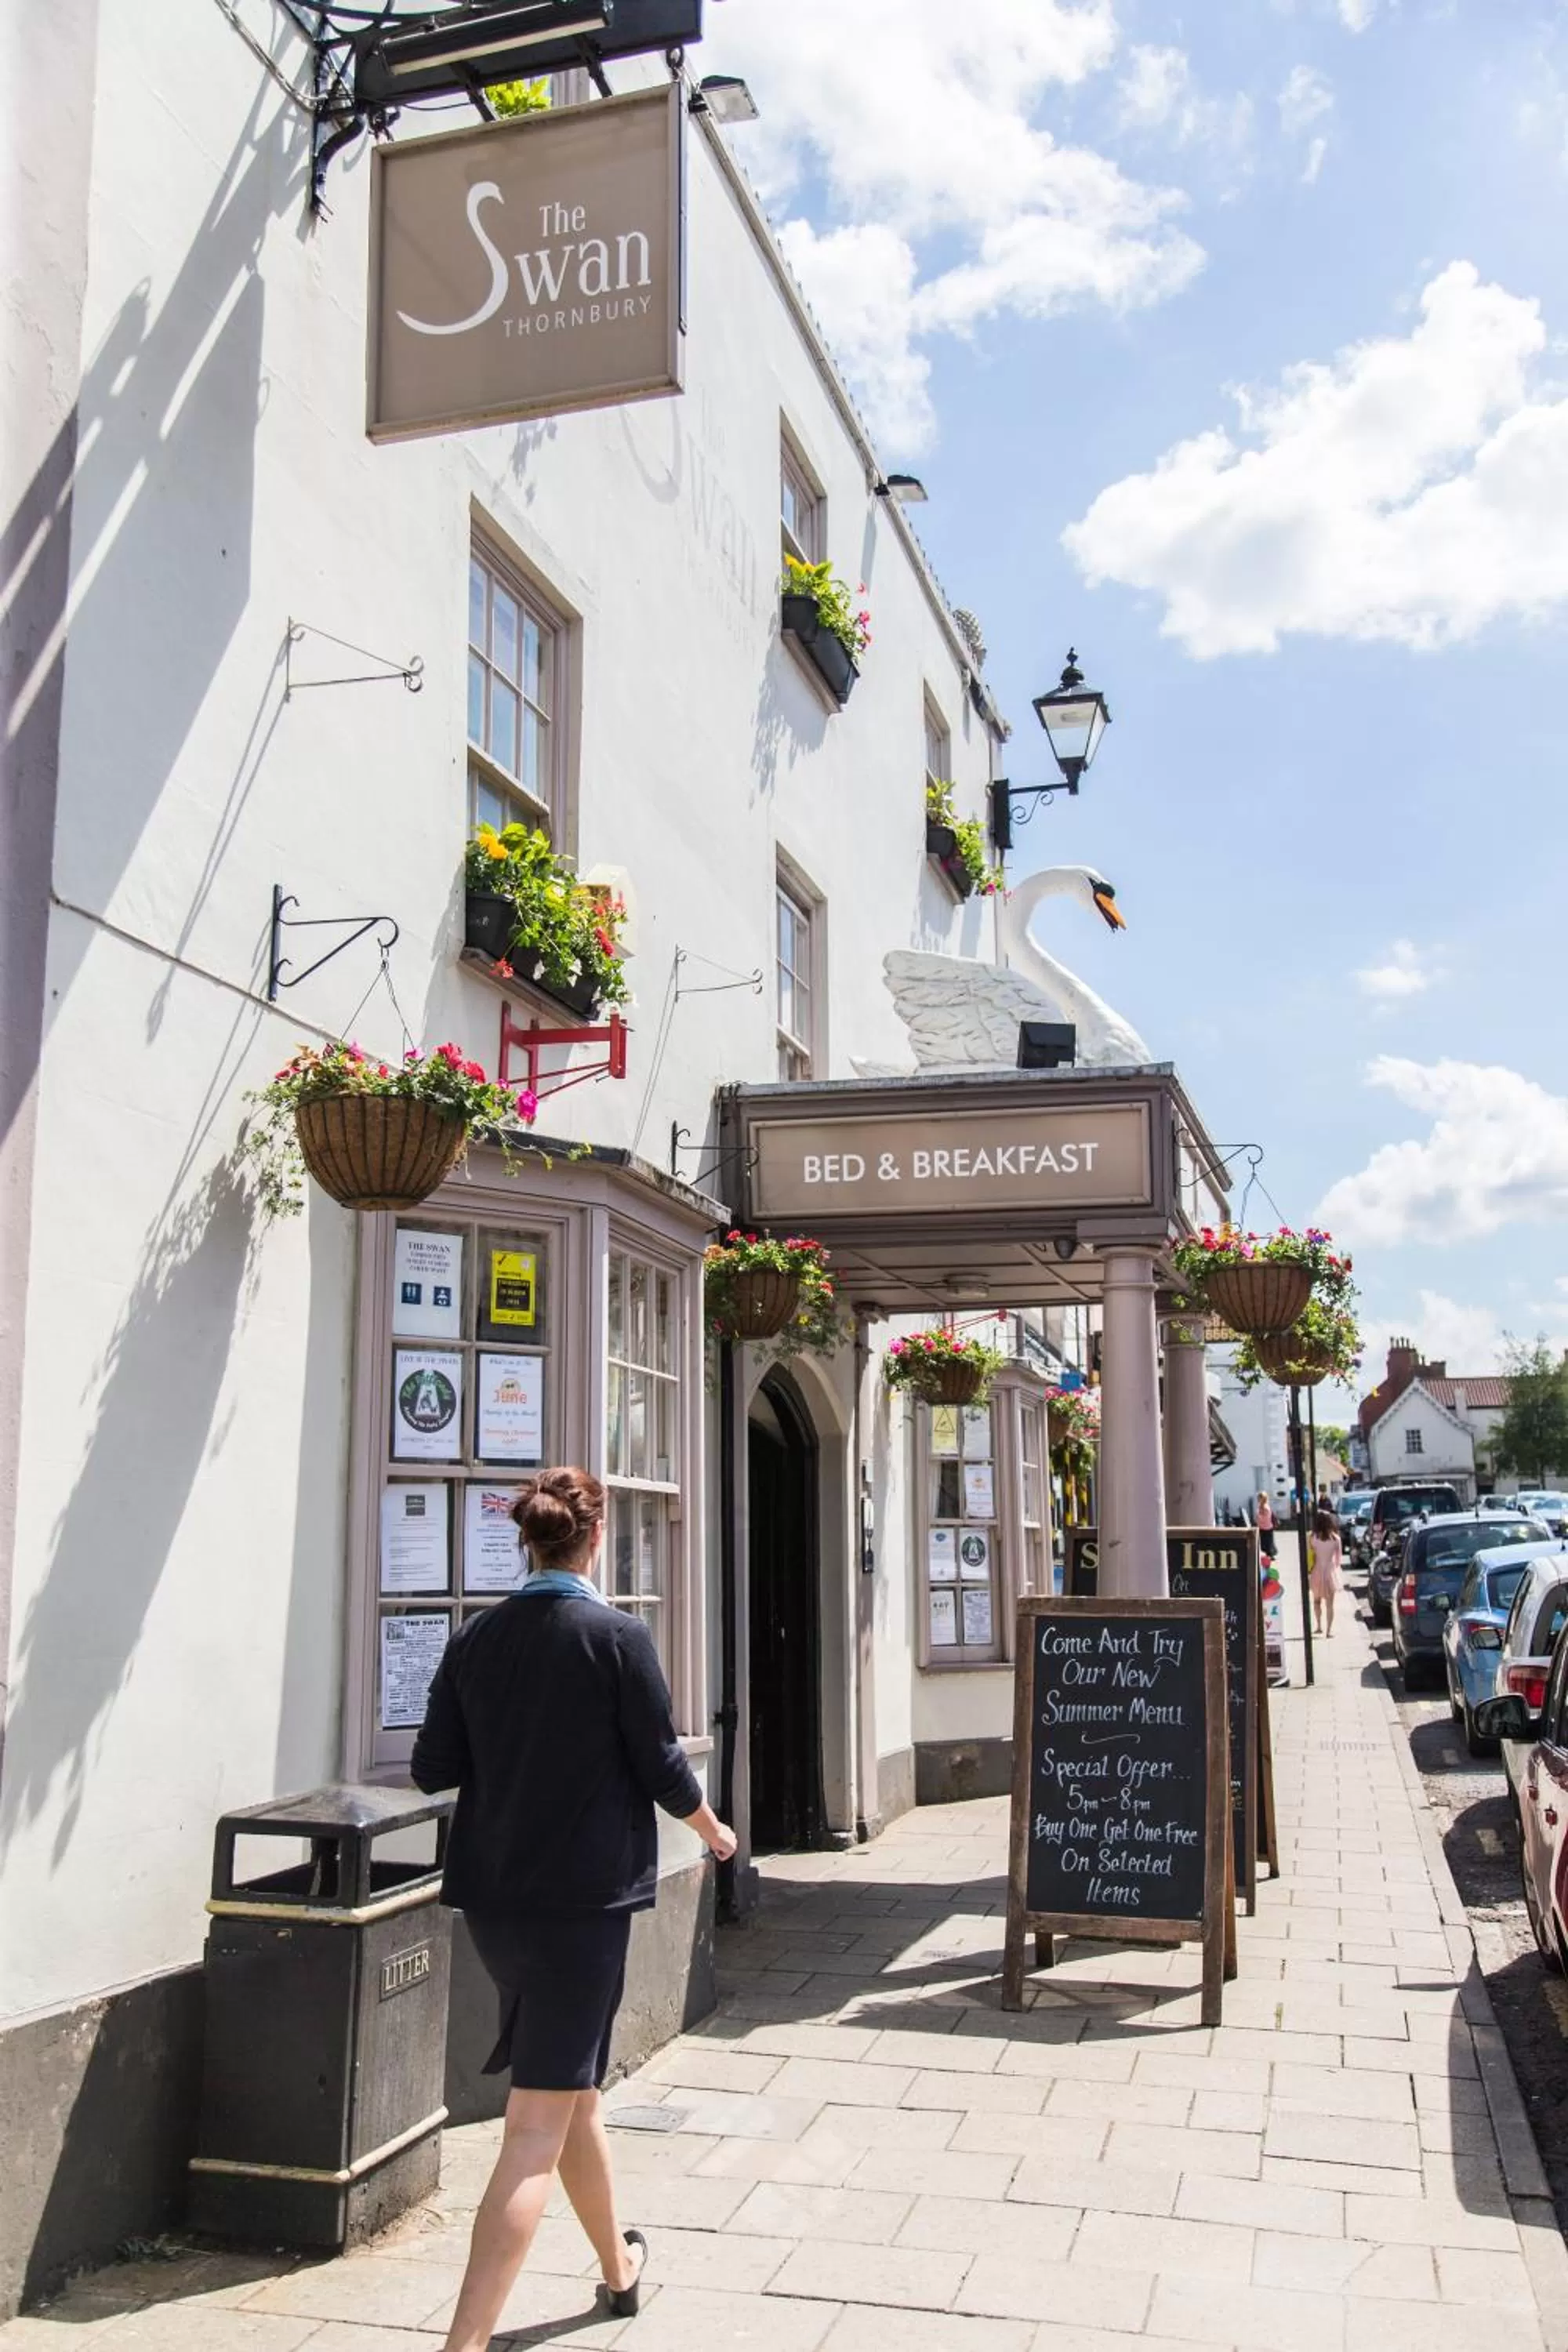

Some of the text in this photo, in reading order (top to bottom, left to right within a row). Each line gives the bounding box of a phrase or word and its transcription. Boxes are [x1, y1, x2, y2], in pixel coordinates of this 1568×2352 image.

[539, 201, 586, 237] The
[397, 181, 652, 336] Swan
[503, 295, 652, 338] THORNBURY
[803, 1142, 1099, 1183] BED & BREAKFAST
[1181, 1542, 1240, 1570] Inn
[1041, 1626, 1184, 1668] Come And Try
[1062, 1658, 1161, 1688] Our New
[1041, 1690, 1186, 1726] Summer Menu
[1041, 1747, 1110, 1788] Special
[1034, 1813, 1198, 1846] Buy One Get One Free
[1061, 1848, 1172, 1876] On Selected
[1086, 1877, 1141, 1905] Items
[383, 1950, 430, 1991] LITTER
